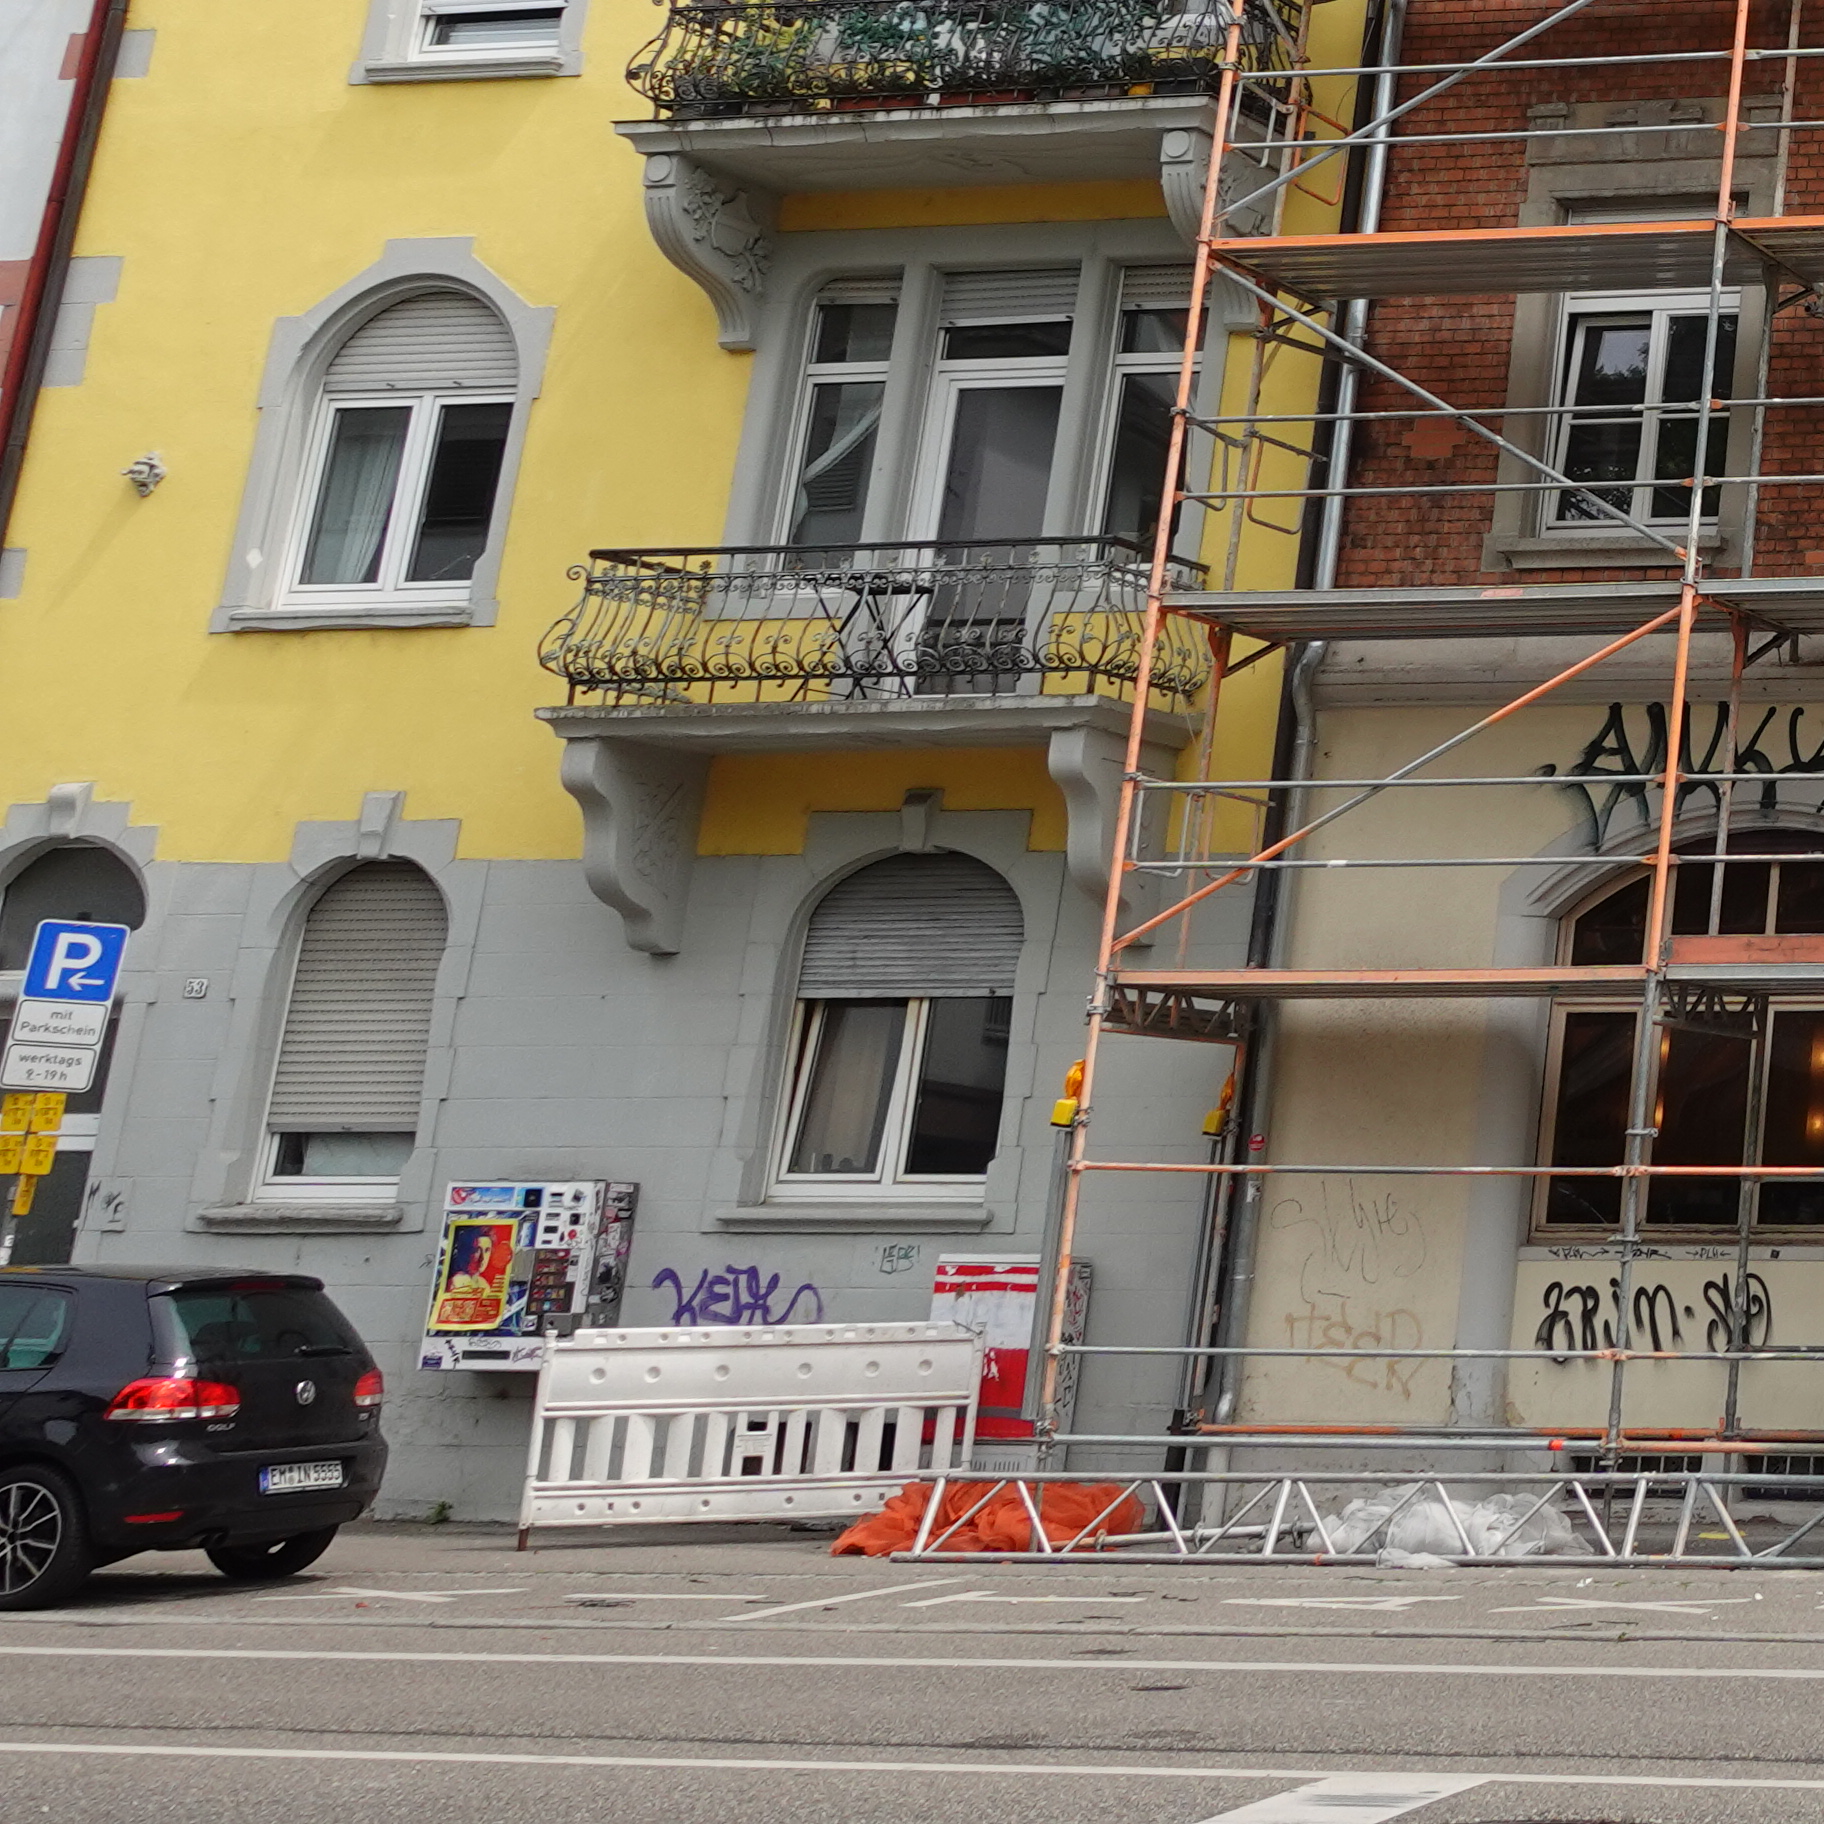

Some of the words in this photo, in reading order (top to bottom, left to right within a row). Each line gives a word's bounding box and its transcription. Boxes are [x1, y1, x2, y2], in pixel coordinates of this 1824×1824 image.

[44, 932, 103, 990] P
[186, 980, 206, 995] 53
[50, 1009, 73, 1021] mit
[20, 1020, 96, 1036] Parkschein
[18, 1052, 83, 1068] werktags
